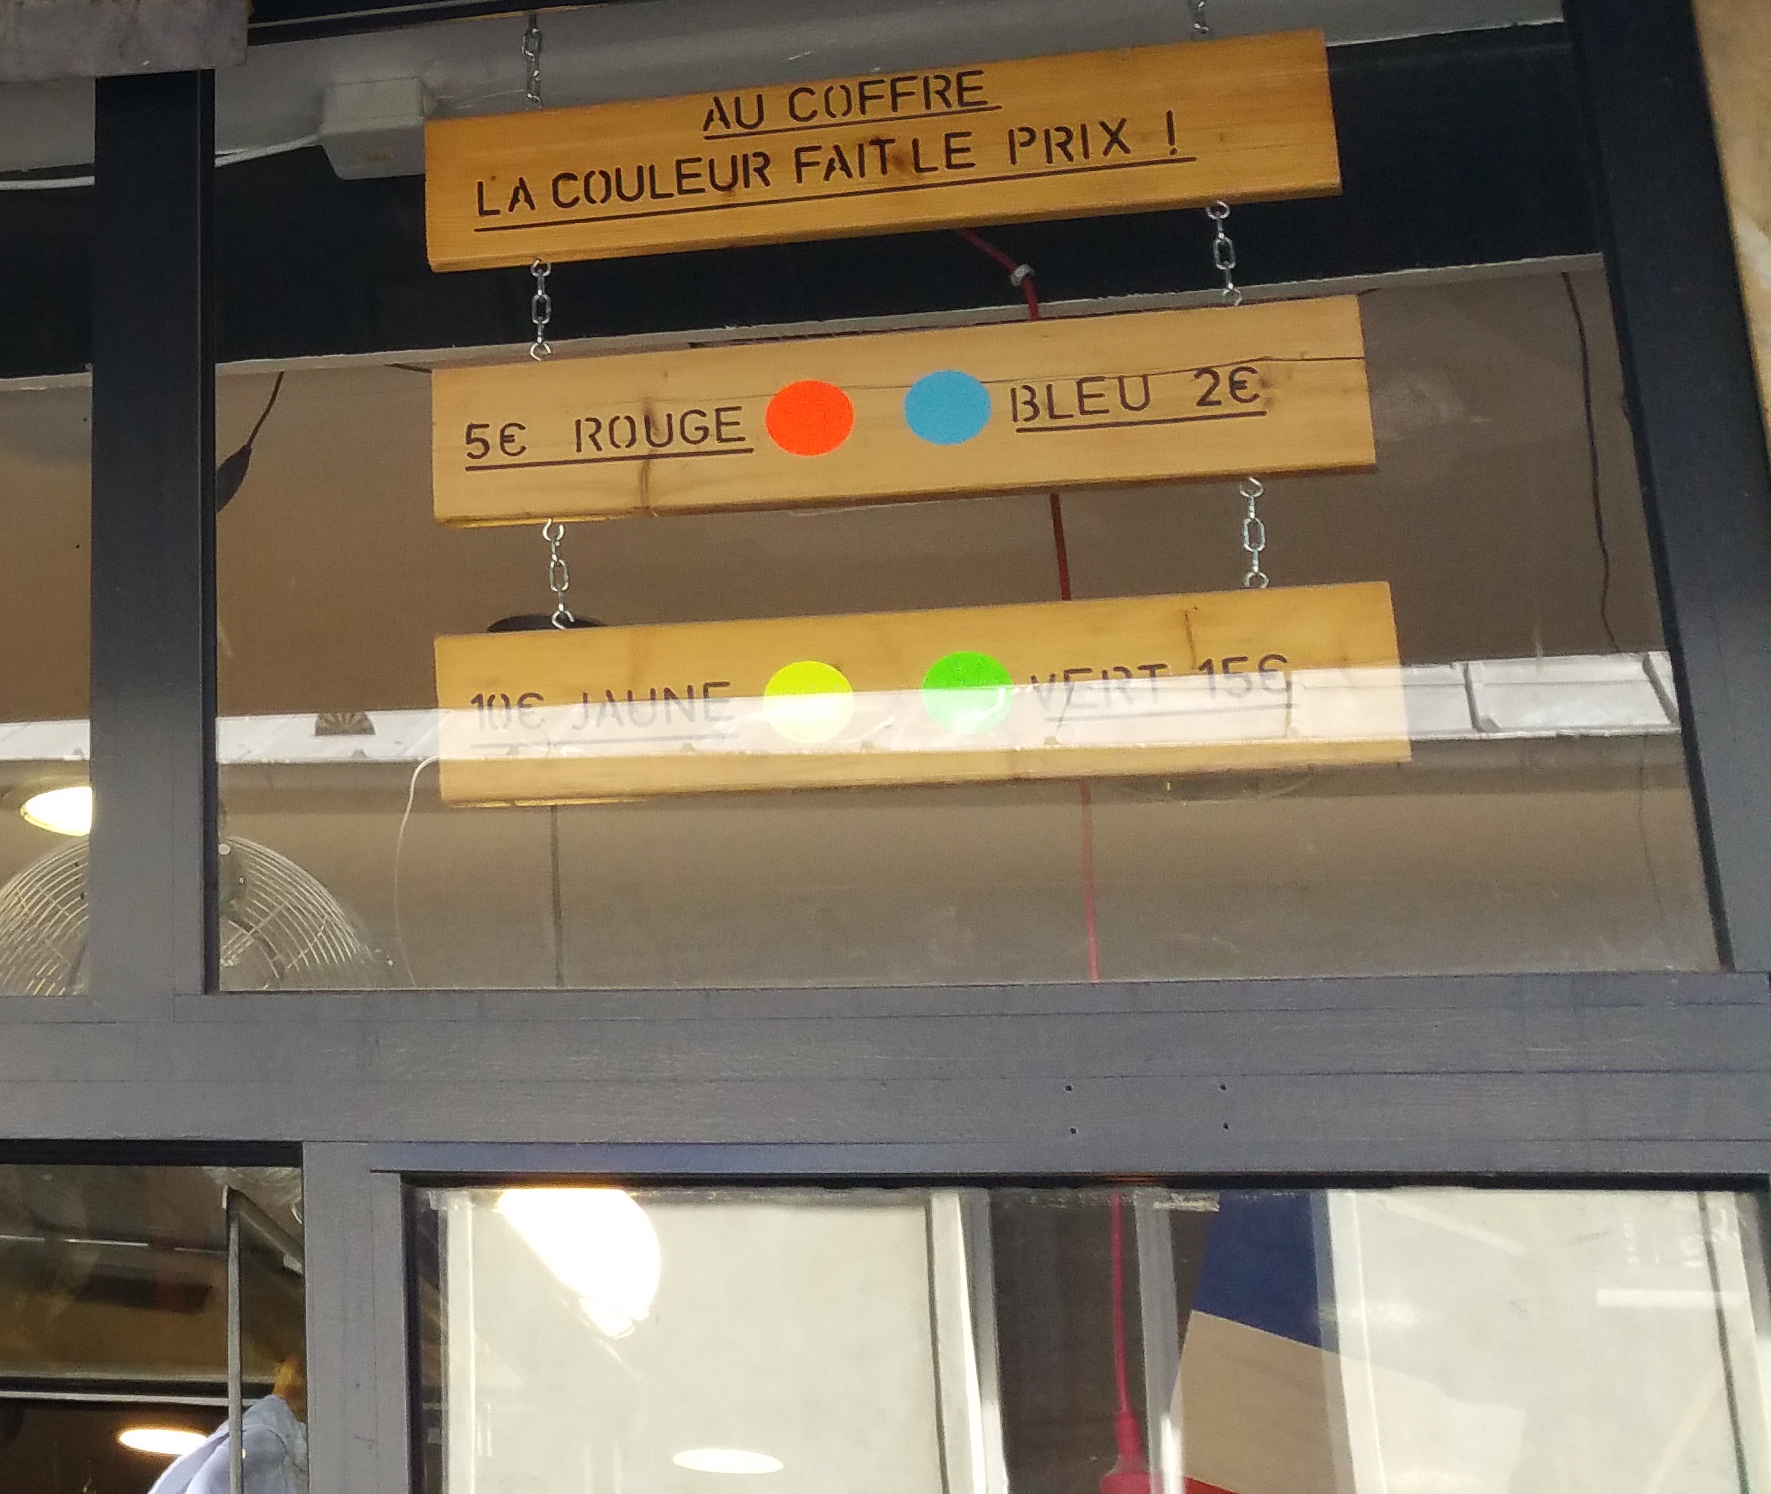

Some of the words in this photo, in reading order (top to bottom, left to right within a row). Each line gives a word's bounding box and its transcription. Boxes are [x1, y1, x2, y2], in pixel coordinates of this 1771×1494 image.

[703, 94, 766, 133] AU
[788, 70, 989, 125] COFFRE
[477, 176, 536, 218] LA
[551, 150, 772, 208] COULEUR
[1009, 118, 1131, 166] PRIX
[1010, 372, 1153, 424] BLEU
[1195, 365, 1262, 409] 2€
[465, 420, 528, 462] 5€
[574, 405, 746, 454] ROUGE
[469, 689, 546, 732] 10€
[570, 680, 737, 731] JAUNE
[1029, 661, 1170, 711] VERT
[1199, 653, 1292, 703] 15€
